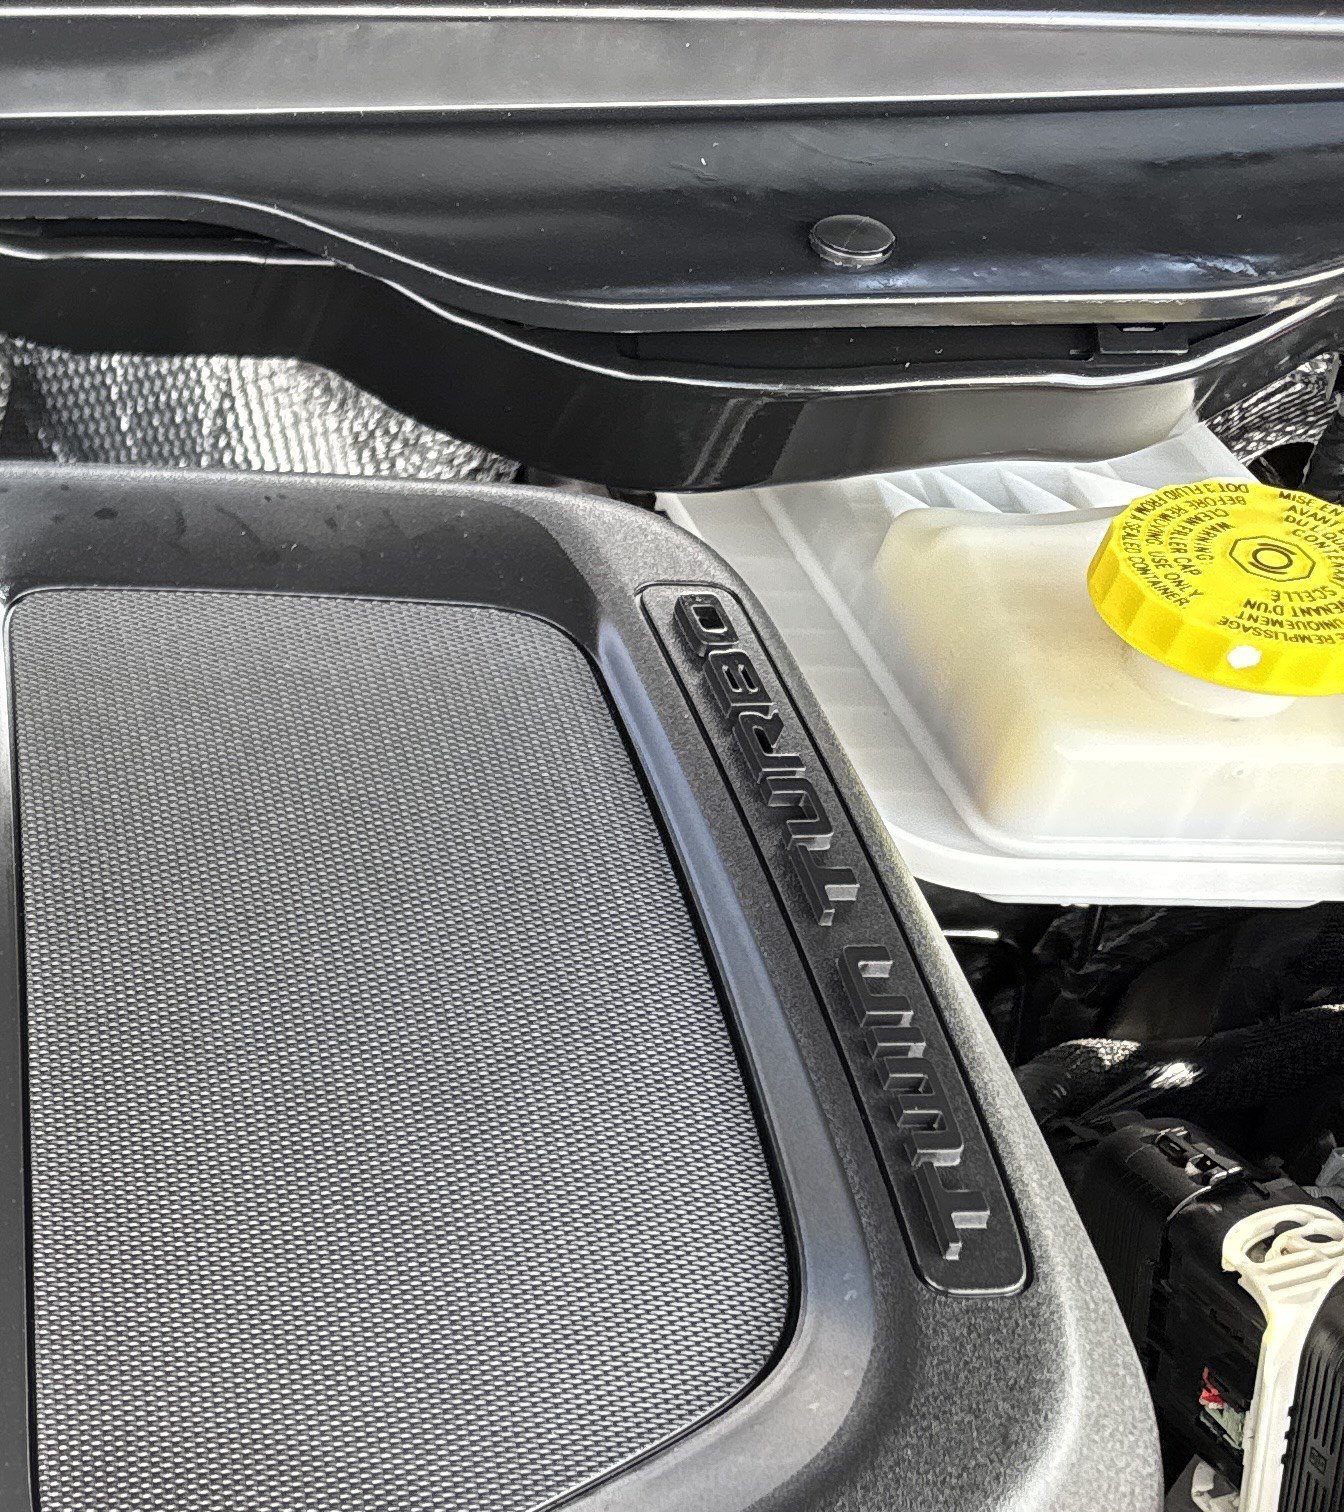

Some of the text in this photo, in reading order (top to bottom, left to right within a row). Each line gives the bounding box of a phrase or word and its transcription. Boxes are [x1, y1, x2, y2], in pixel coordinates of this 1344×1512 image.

[1163, 485, 1203, 500] FLUID
[1203, 483, 1216, 493] 3
[1217, 483, 1249, 493] DOT
[1182, 495, 1247, 510] BEFORE
[1278, 490, 1316, 507] MISE
[1183, 508, 1229, 526] CLEAN
[1284, 515, 1309, 527] DU
[1122, 521, 1142, 553] SEALED
[1147, 550, 1174, 569] USE
[1173, 557, 1202, 576] CAP
[1164, 572, 1204, 597] ONLY
[1217, 615, 1336, 645] REMPLISSAGE
[1235, 610, 1344, 632] UNIQUEMENT
[673, 592, 991, 1261] TWIN TURBO
